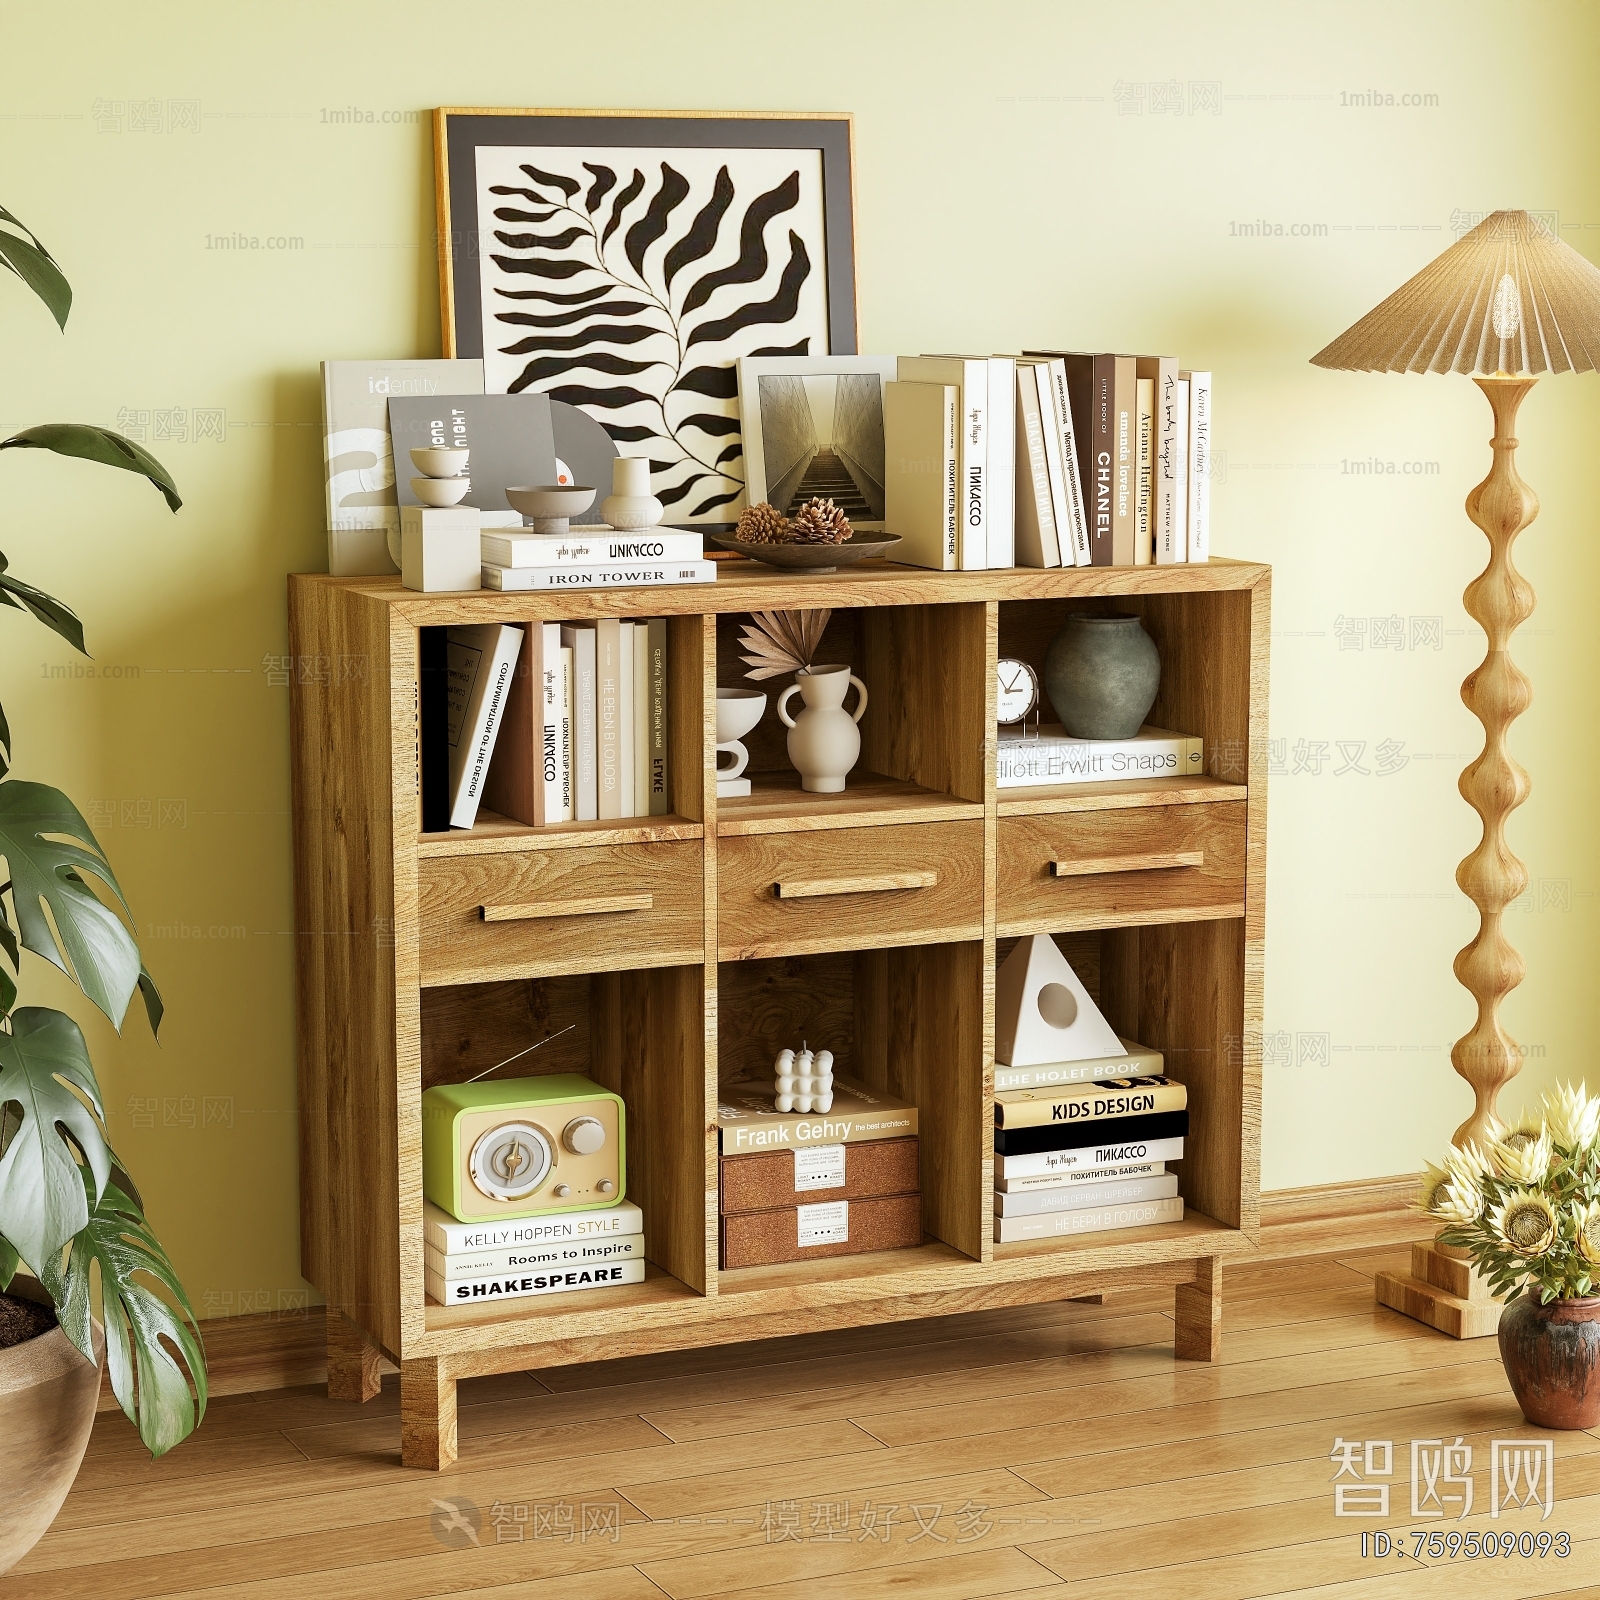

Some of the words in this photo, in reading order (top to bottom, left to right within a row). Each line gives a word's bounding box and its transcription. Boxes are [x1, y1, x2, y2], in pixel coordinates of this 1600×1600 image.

[368, 375, 439, 396] identity
[1164, 375, 1174, 401] The
[1197, 388, 1208, 417] Karen
[452, 408, 468, 447] NIGHT
[1026, 412, 1046, 470] СПАСИТЕ
[1119, 411, 1130, 461] amanda
[1140, 412, 1152, 461] Arianna
[1064, 432, 1073, 457] Метод
[1194, 420, 1208, 474] McCartney
[969, 466, 982, 526] ПИКАССО
[1064, 458, 1079, 508] управления
[1097, 452, 1110, 538] CHANEL
[1119, 464, 1130, 517] lovelace
[1034, 474, 1052, 529] КОТИКА!
[1138, 466, 1150, 533] Huffington
[1073, 508, 1085, 551] проектами
[548, 574, 593, 584] IRON
[599, 571, 666, 582] TOWER
[1048, 754, 1104, 776] Erwitt
[1111, 752, 1178, 773] Snaps
[1052, 1101, 1090, 1121] KIDS
[1094, 1094, 1155, 1116] DESIGN
[736, 1124, 790, 1147] Frank
[795, 1121, 853, 1141] Gehry
[855, 1123, 866, 1132] the
[866, 1122, 880, 1131] best
[880, 1119, 910, 1130] architects
[1095, 1145, 1147, 1163] ПИКАССО
[1070, 1168, 1118, 1181] ПОХИТИТЕЛЬ
[1119, 1164, 1152, 1176] БАБОЧЕК
[1040, 1194, 1068, 1209] ДАВИД
[1070, 1186, 1144, 1206] СЕРВАН-ШРЕЙБЕР
[464, 1231, 509, 1247] KELLY
[514, 1224, 572, 1242] HOPPEN
[577, 1218, 620, 1234] STYLE
[1055, 1218, 1070, 1231] НЕ
[1072, 1214, 1101, 1229] БЕРИ
[1104, 1213, 1111, 1225] В
[1114, 1206, 1158, 1224] ГОЛОВУ
[508, 1252, 558, 1266] Rooms
[562, 1250, 578, 1259] to
[582, 1242, 632, 1257] Inspire
[456, 1267, 623, 1298] SHAKESPEARE
